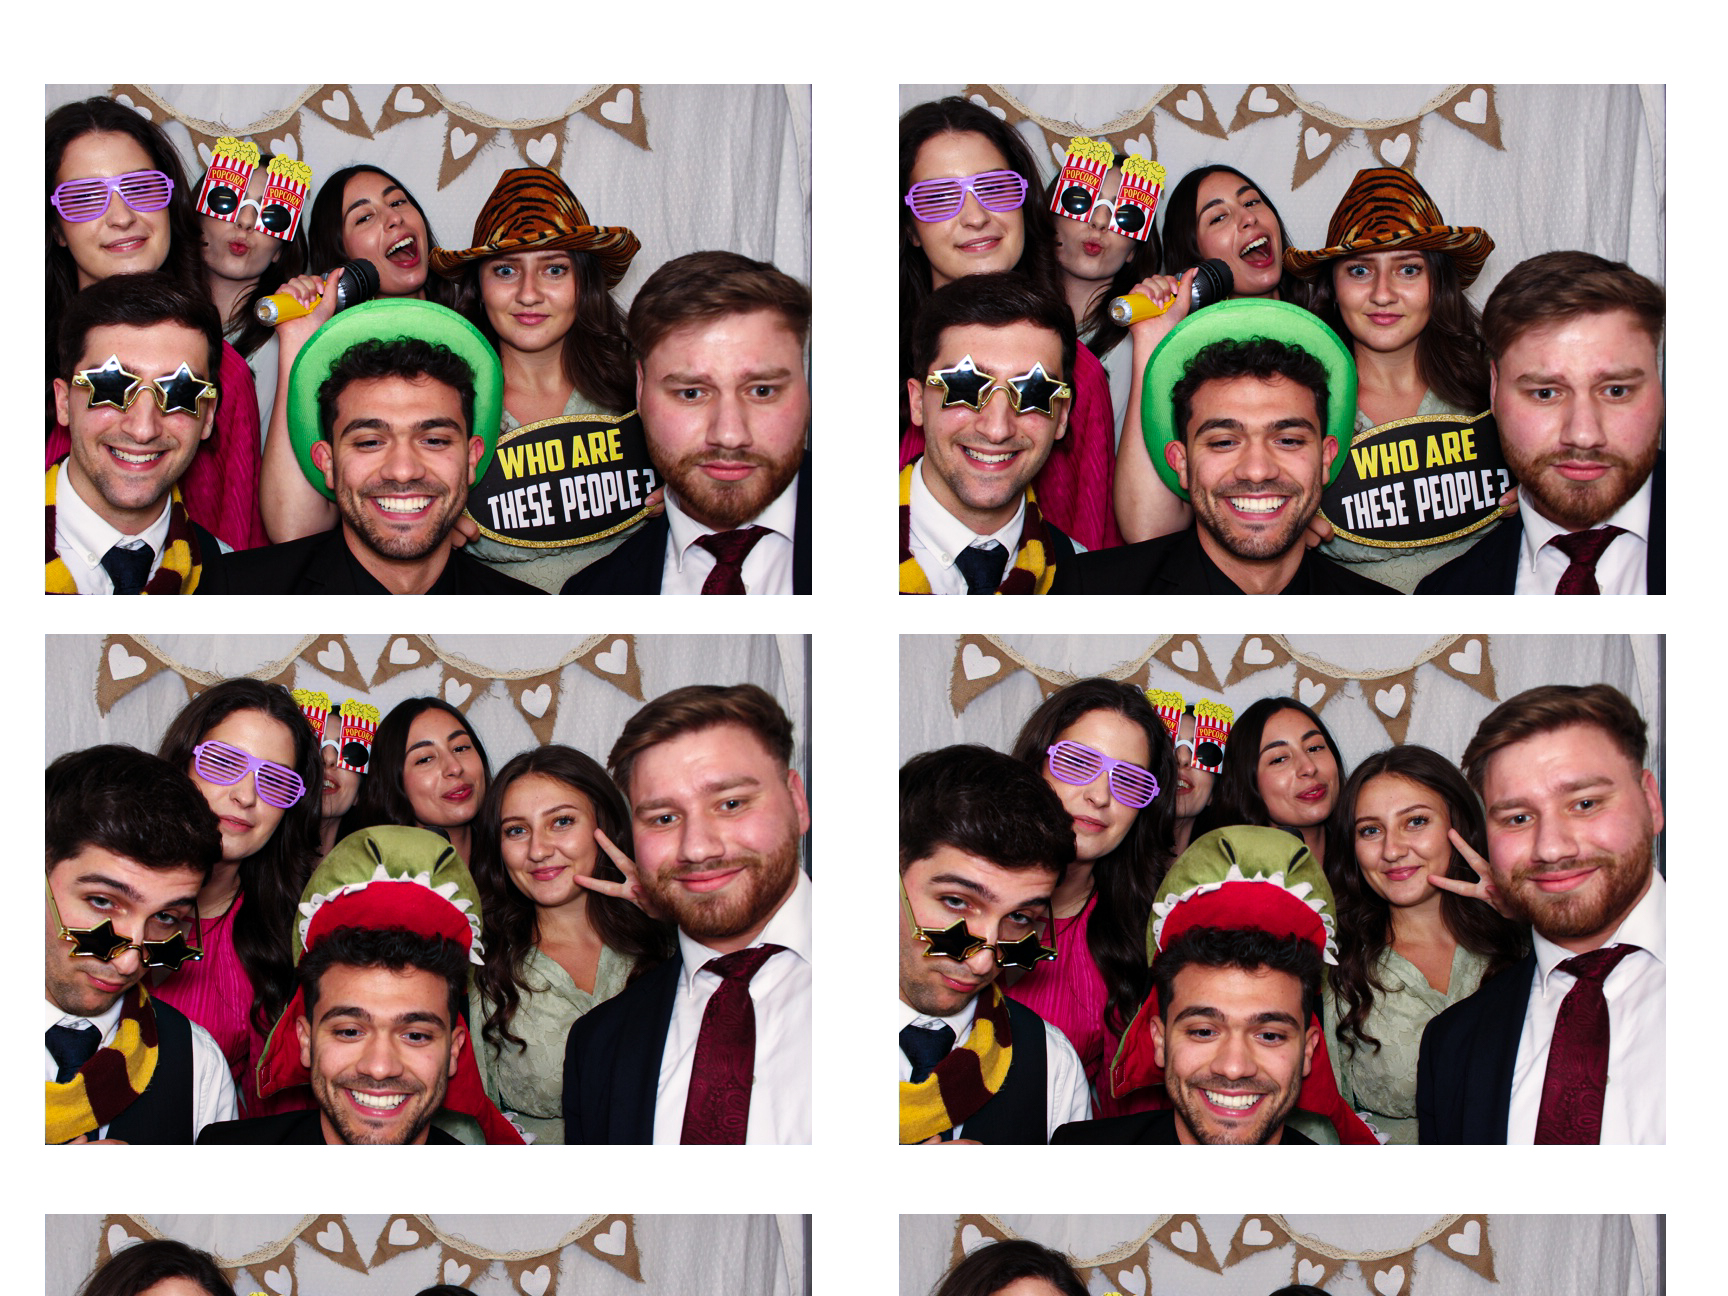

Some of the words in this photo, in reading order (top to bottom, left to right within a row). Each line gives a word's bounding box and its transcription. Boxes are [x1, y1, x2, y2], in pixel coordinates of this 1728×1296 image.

[211, 169, 246, 187] POPCORN
[1065, 169, 1100, 187] POPCORN
[269, 187, 302, 207] POPCORN
[1123, 187, 1156, 207] POPCORN
[496, 439, 566, 480] WHO
[572, 428, 624, 468] ARE
[1350, 439, 1420, 480] WHO
[1426, 428, 1478, 468] ARE
[487, 481, 556, 530] THESE
[1341, 481, 1410, 530] THESE
